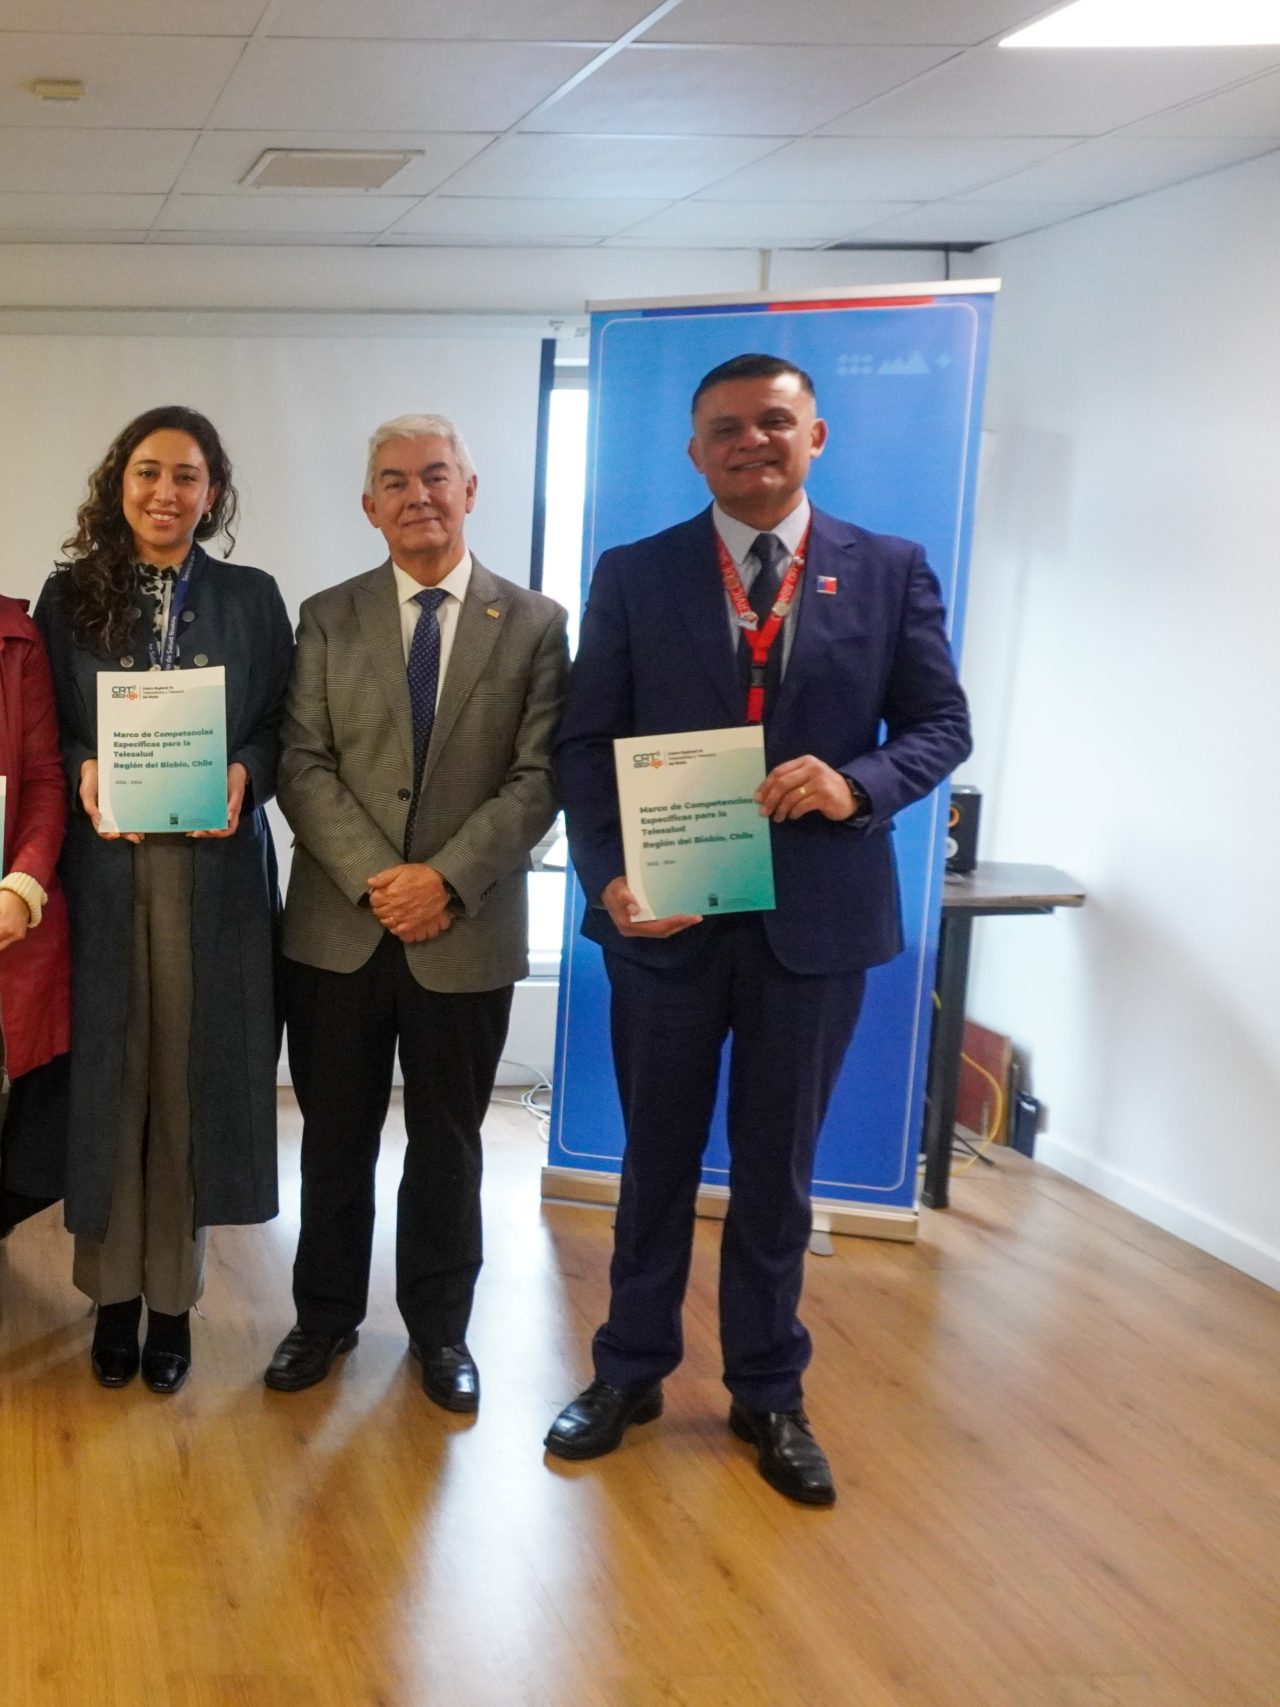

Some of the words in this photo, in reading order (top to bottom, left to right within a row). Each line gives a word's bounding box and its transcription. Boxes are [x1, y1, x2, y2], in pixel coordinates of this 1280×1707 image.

[165, 636, 175, 654] Salud
[164, 654, 171, 662] de
[154, 729, 214, 738] Competencias
[114, 741, 160, 749] Específicas
[633, 752, 656, 763] CRT
[114, 761, 143, 770] Región
[145, 761, 158, 769] del
[160, 760, 190, 769] Biobío,
[192, 759, 213, 767] Chile
[640, 805, 667, 814] Marco
[671, 802, 682, 811] de
[641, 815, 692, 825] Específicas
[695, 812, 716, 821] para
[718, 810, 727, 818] la
[642, 825, 686, 836] Telesalud
[643, 838, 675, 849] Región
[677, 836, 692, 845] del
[695, 833, 728, 843] Biobío,
[730, 832, 754, 840] Chile
